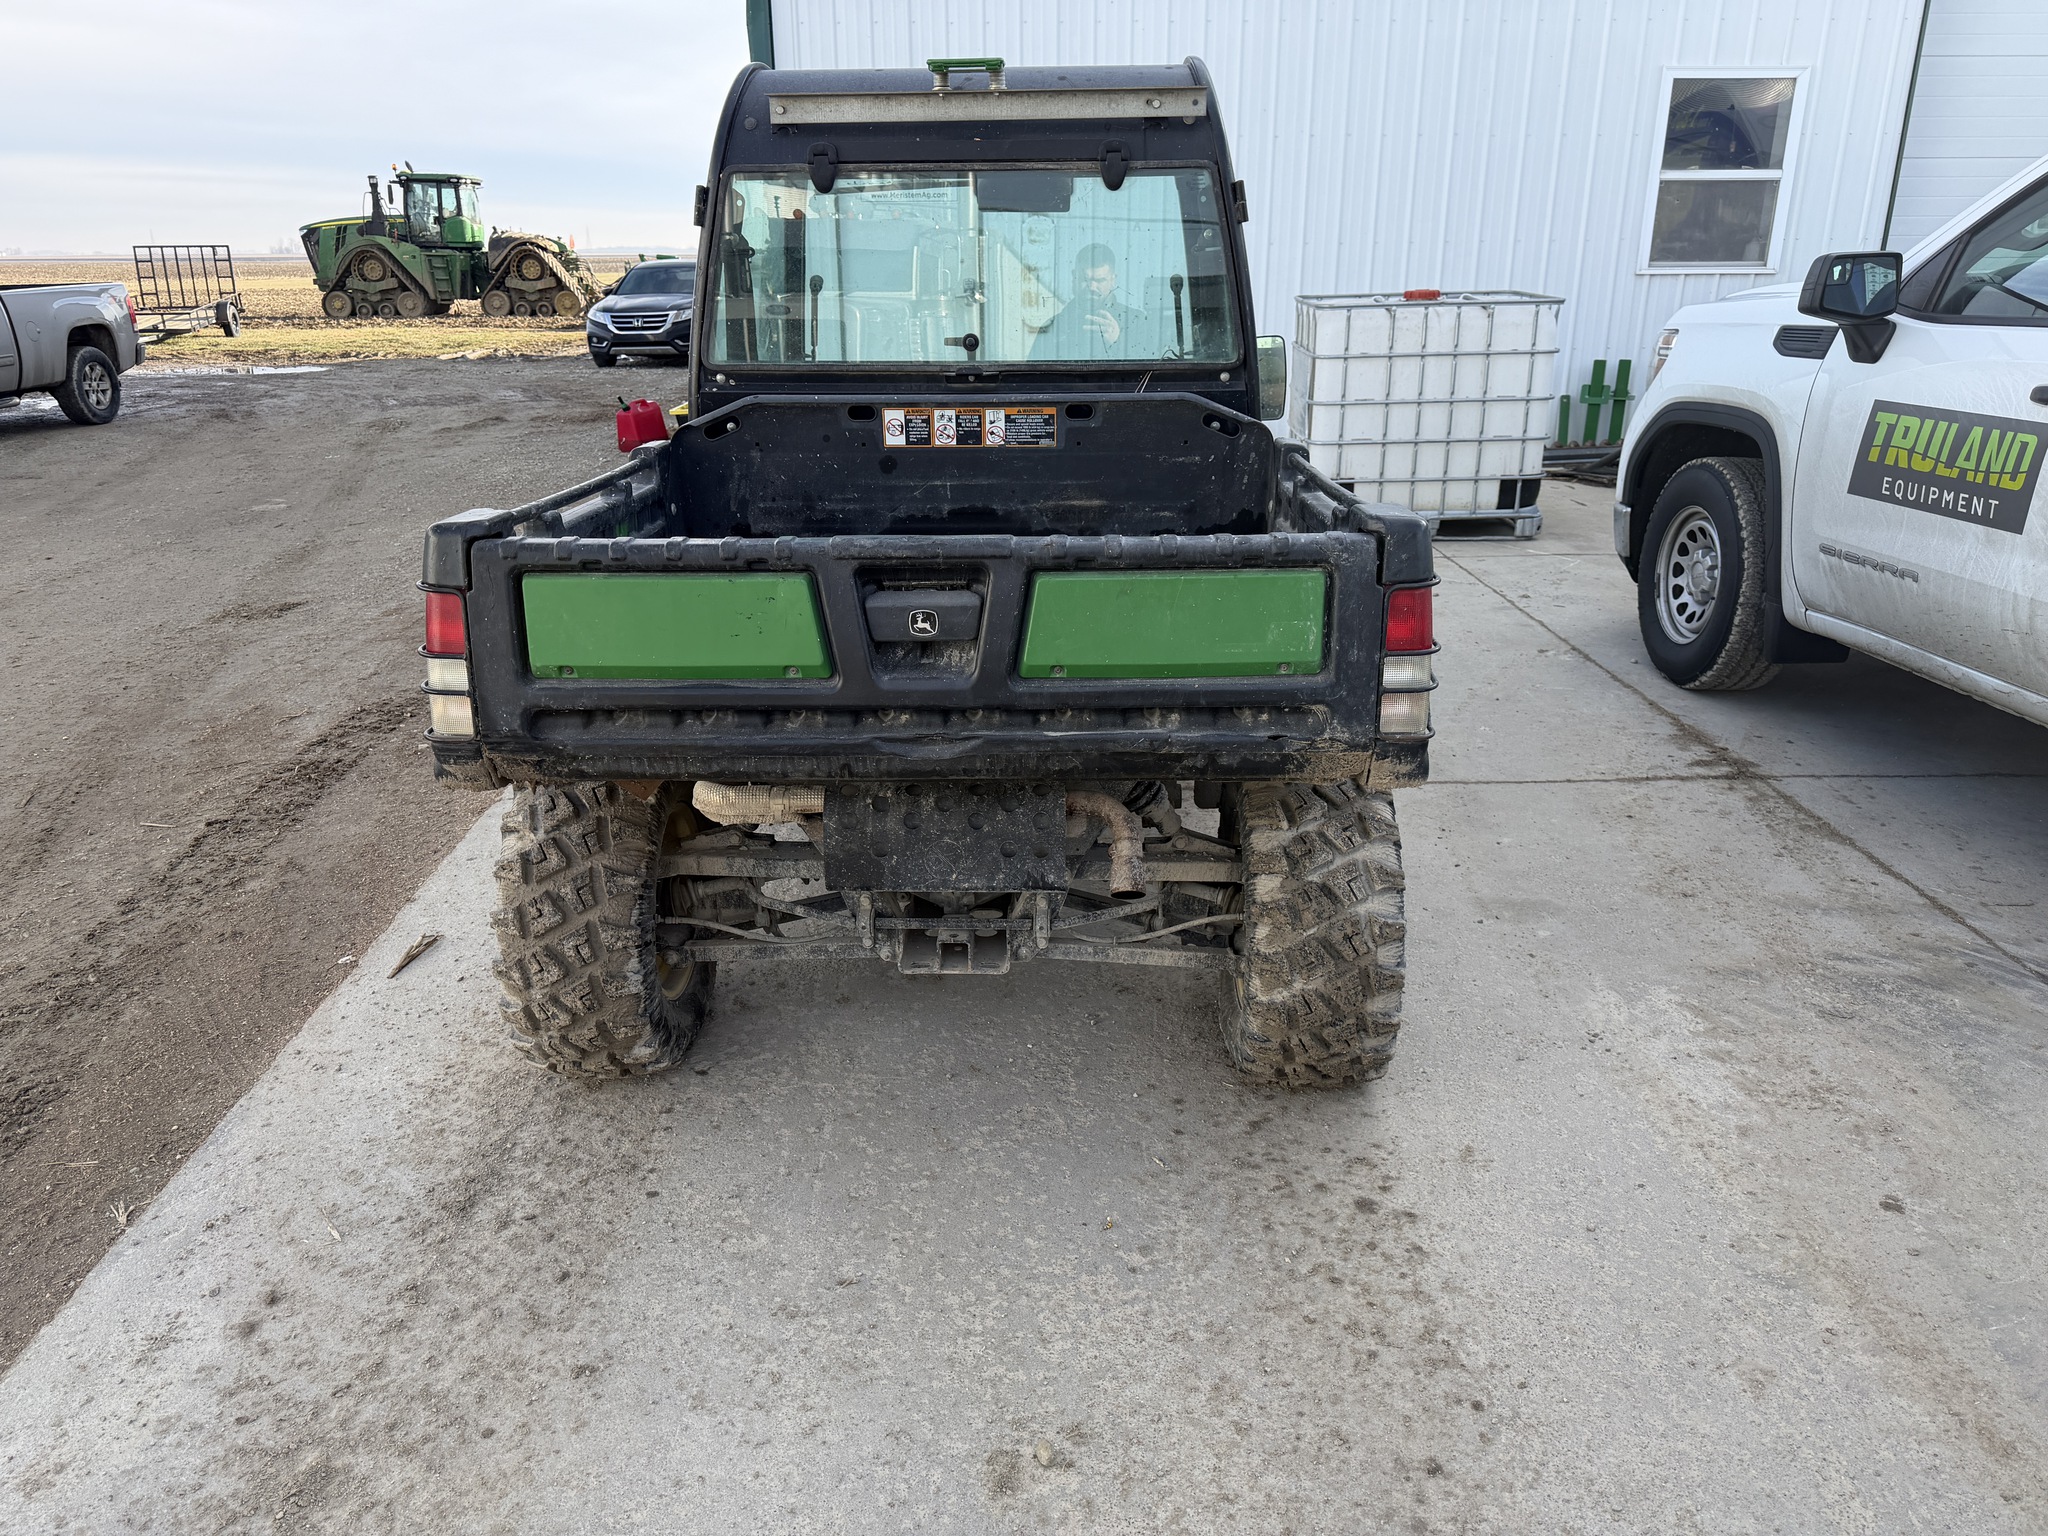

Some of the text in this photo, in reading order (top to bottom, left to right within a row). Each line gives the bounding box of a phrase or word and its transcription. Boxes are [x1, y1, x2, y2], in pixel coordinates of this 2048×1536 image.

[1868, 411, 2038, 491] TRULAND
[1881, 476, 1999, 519] EQUIPMENT
[1819, 542, 1919, 583] SIERRA
